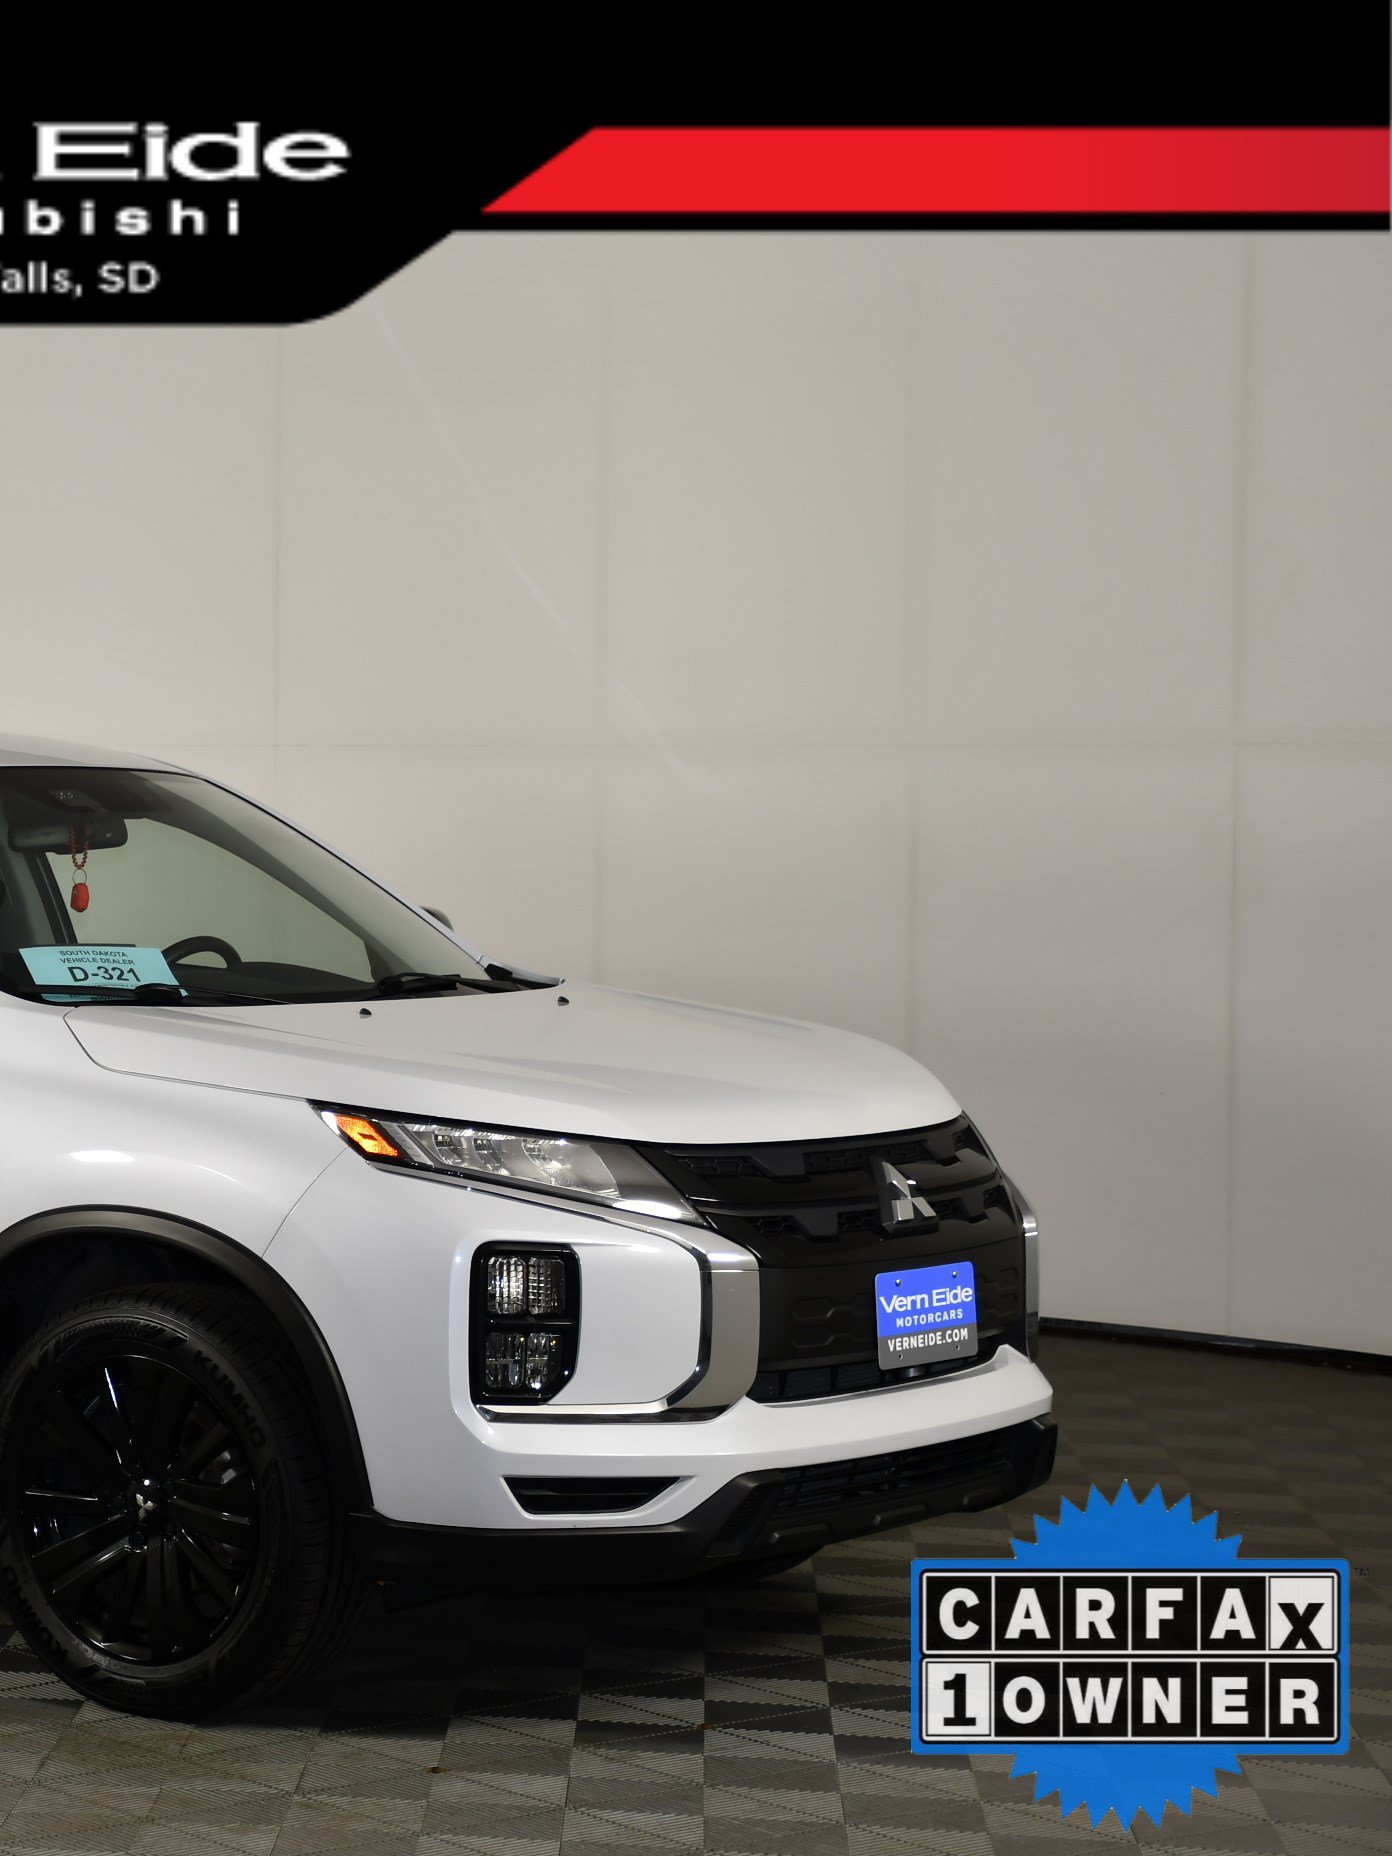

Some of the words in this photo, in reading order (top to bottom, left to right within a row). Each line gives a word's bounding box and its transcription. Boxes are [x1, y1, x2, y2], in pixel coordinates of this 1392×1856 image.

[92, 950, 128, 958] DAKOTA
[100, 957, 134, 965] DEALER
[67, 966, 141, 983] D-321
[879, 1294, 929, 1314] Vern
[932, 1285, 974, 1307] Eide
[896, 1308, 964, 1328] MOTORCARS
[887, 1328, 969, 1352] VERNEIDE.COM
[193, 1350, 266, 1449] KUMHO
